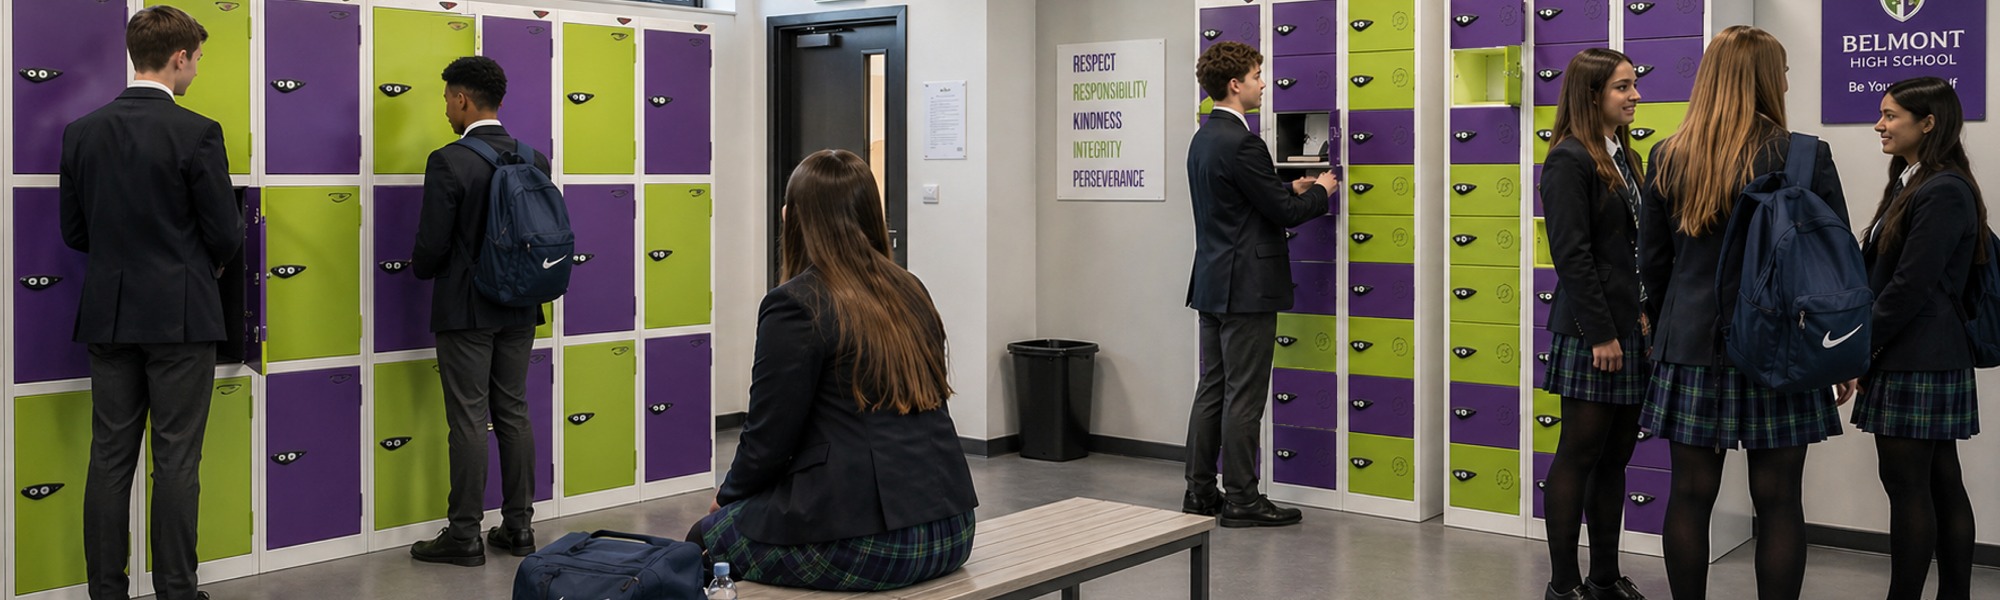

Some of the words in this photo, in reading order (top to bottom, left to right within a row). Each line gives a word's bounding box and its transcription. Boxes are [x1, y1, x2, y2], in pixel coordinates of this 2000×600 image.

[1842, 30, 1965, 53] BELMONT
[1073, 53, 1116, 72] RESPECT
[1850, 56, 1888, 68] HIGH
[1892, 54, 1957, 67] SCHOOL
[1073, 80, 1147, 101] RESPONSIBILITY
[1849, 82, 1864, 92] Be
[1867, 78, 1958, 92] Youlf
[1073, 111, 1122, 130] KINDNESS
[1073, 140, 1122, 159] INTEGRITY
[1073, 169, 1145, 188] PERSEVERANCE
